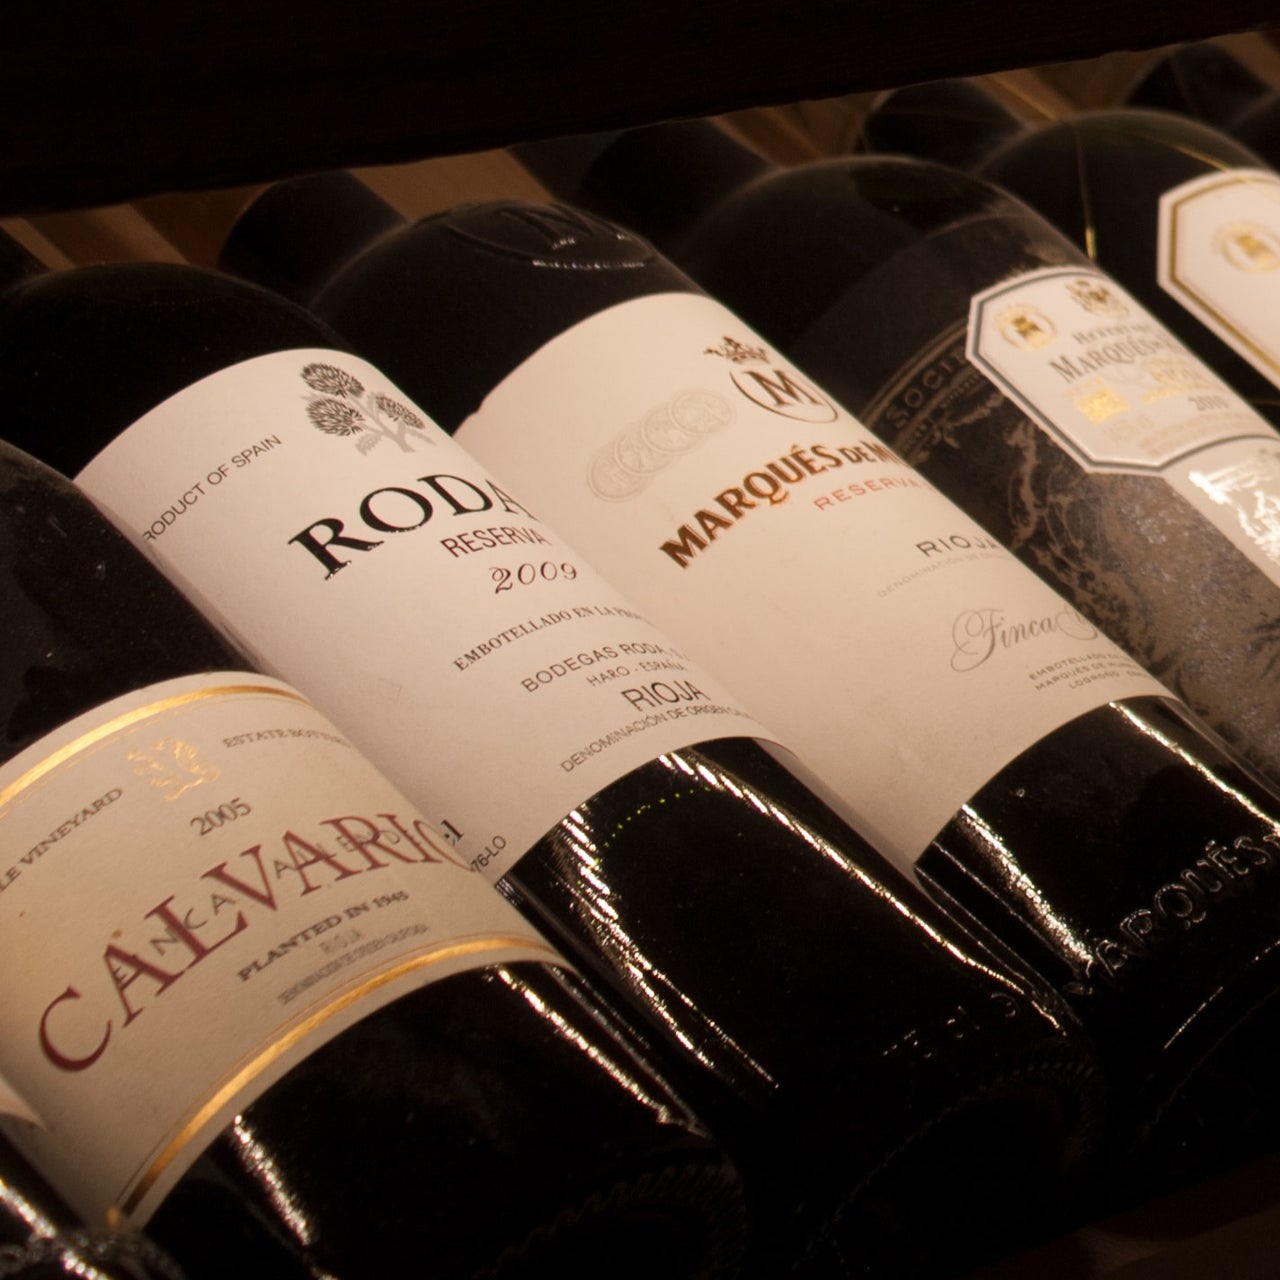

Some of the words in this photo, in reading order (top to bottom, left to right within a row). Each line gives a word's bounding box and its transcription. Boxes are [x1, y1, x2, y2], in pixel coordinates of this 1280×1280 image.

[206, 463, 230, 486] OF
[230, 433, 283, 469] SPAIN
[286, 473, 544, 582] RODA
[656, 442, 846, 571] MARQUÉS
[439, 525, 553, 559] RESERVA
[488, 560, 579, 595] 2009
[452, 609, 572, 672] EMBOTELLADO
[520, 645, 619, 693] BODEGAS
[586, 665, 630, 687] HARO
[620, 678, 712, 712] RIOJA
[559, 712, 668, 773] DENOMINACIÓN
[667, 707, 687, 721] DE
[19, 785, 125, 866] VINEYARD
[189, 796, 253, 837] 2005
[236, 913, 344, 984] PLANTED
[342, 901, 371, 920] IN
